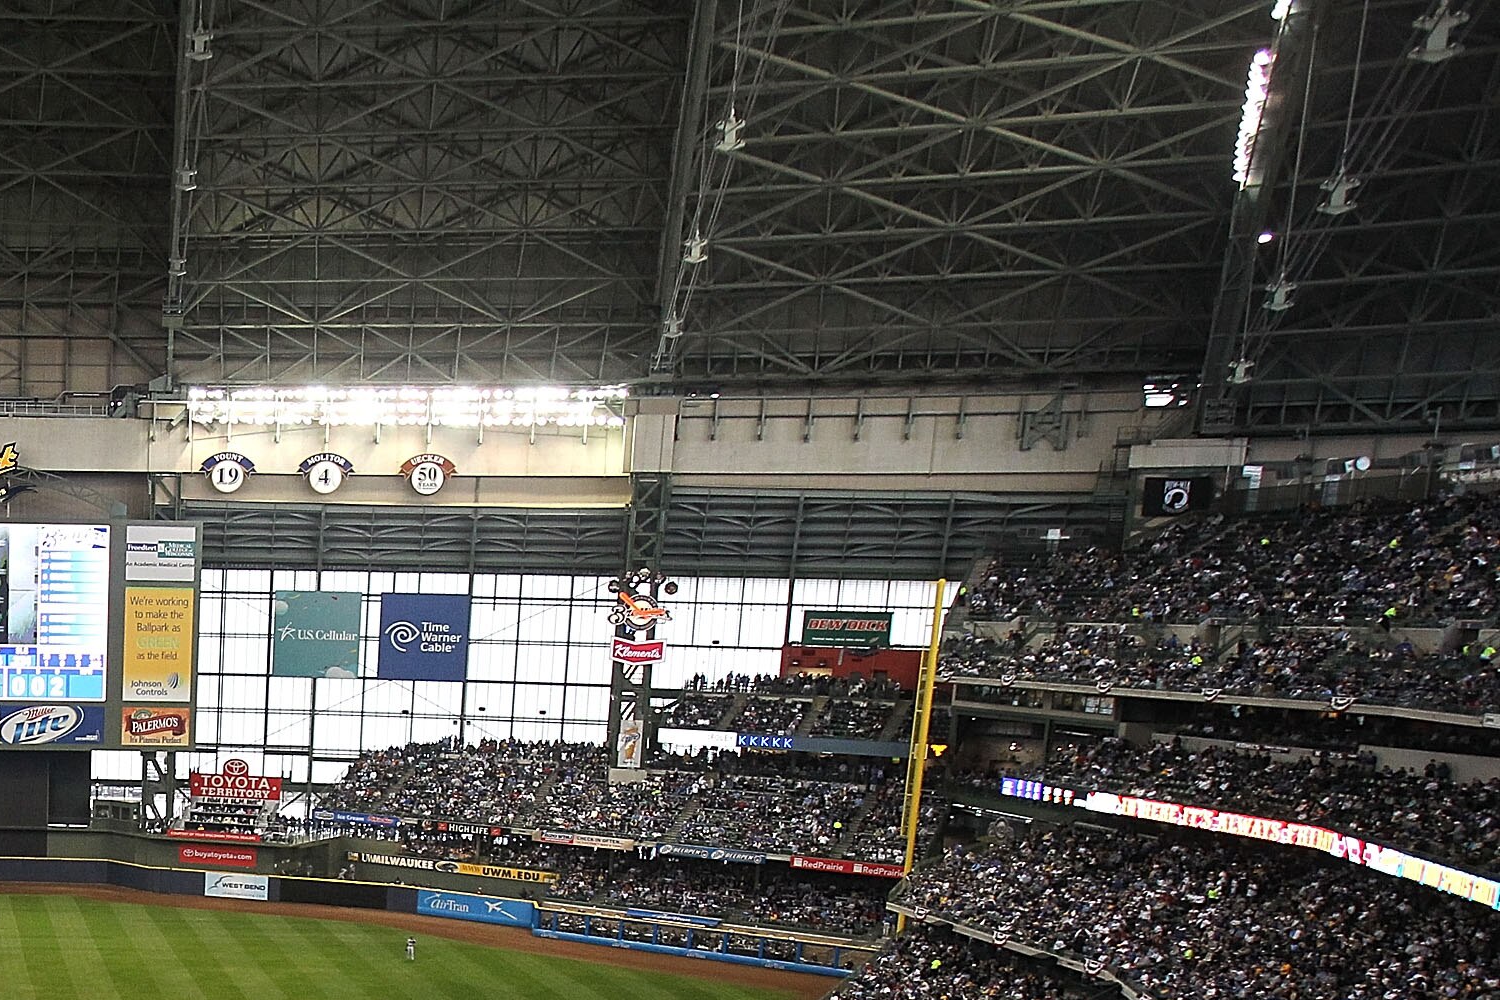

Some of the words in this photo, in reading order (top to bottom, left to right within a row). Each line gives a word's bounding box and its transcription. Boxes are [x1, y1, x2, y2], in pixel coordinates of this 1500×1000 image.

[213, 453, 244, 463] YOUNT
[306, 455, 346, 467] MOLITOR
[411, 455, 444, 465] UECKER
[216, 467, 239, 485] 19
[319, 467, 330, 486] 4
[418, 467, 437, 481] 50
[130, 596, 154, 606] We're
[156, 596, 189, 608] working
[135, 610, 143, 619] to
[145, 610, 168, 619] make
[170, 610, 184, 619] the
[137, 622, 169, 633] Ballpark
[172, 624, 181, 632] as
[421, 622, 450, 632] Time
[807, 619, 846, 630] DEW
[845, 620, 888, 632] DECK
[315, 630, 357, 641] Cellular
[421, 632, 461, 643] Warner
[136, 636, 180, 649] GREEN
[420, 642, 449, 653] Cable
[147, 651, 160, 660] the
[614, 644, 661, 658] Klement's
[50, 676, 64, 697] 2
[131, 680, 162, 688] Johnson
[136, 688, 168, 696] Controls
[23, 708, 56, 720] Miller
[12, 715, 69, 744] Lite
[132, 717, 178, 733] PALERMO'S
[201, 775, 270, 790] TOYOTA
[201, 787, 270, 799] TERRITORY
[449, 822, 469, 834] HIGH
[471, 826, 489, 836] LIFE
[194, 848, 252, 860] buyatoyota.com
[803, 861, 844, 871] RedPrairie
[863, 866, 904, 877] RedPrairie
[482, 867, 540, 881] UWM.EDU
[244, 883, 266, 891] BEND
